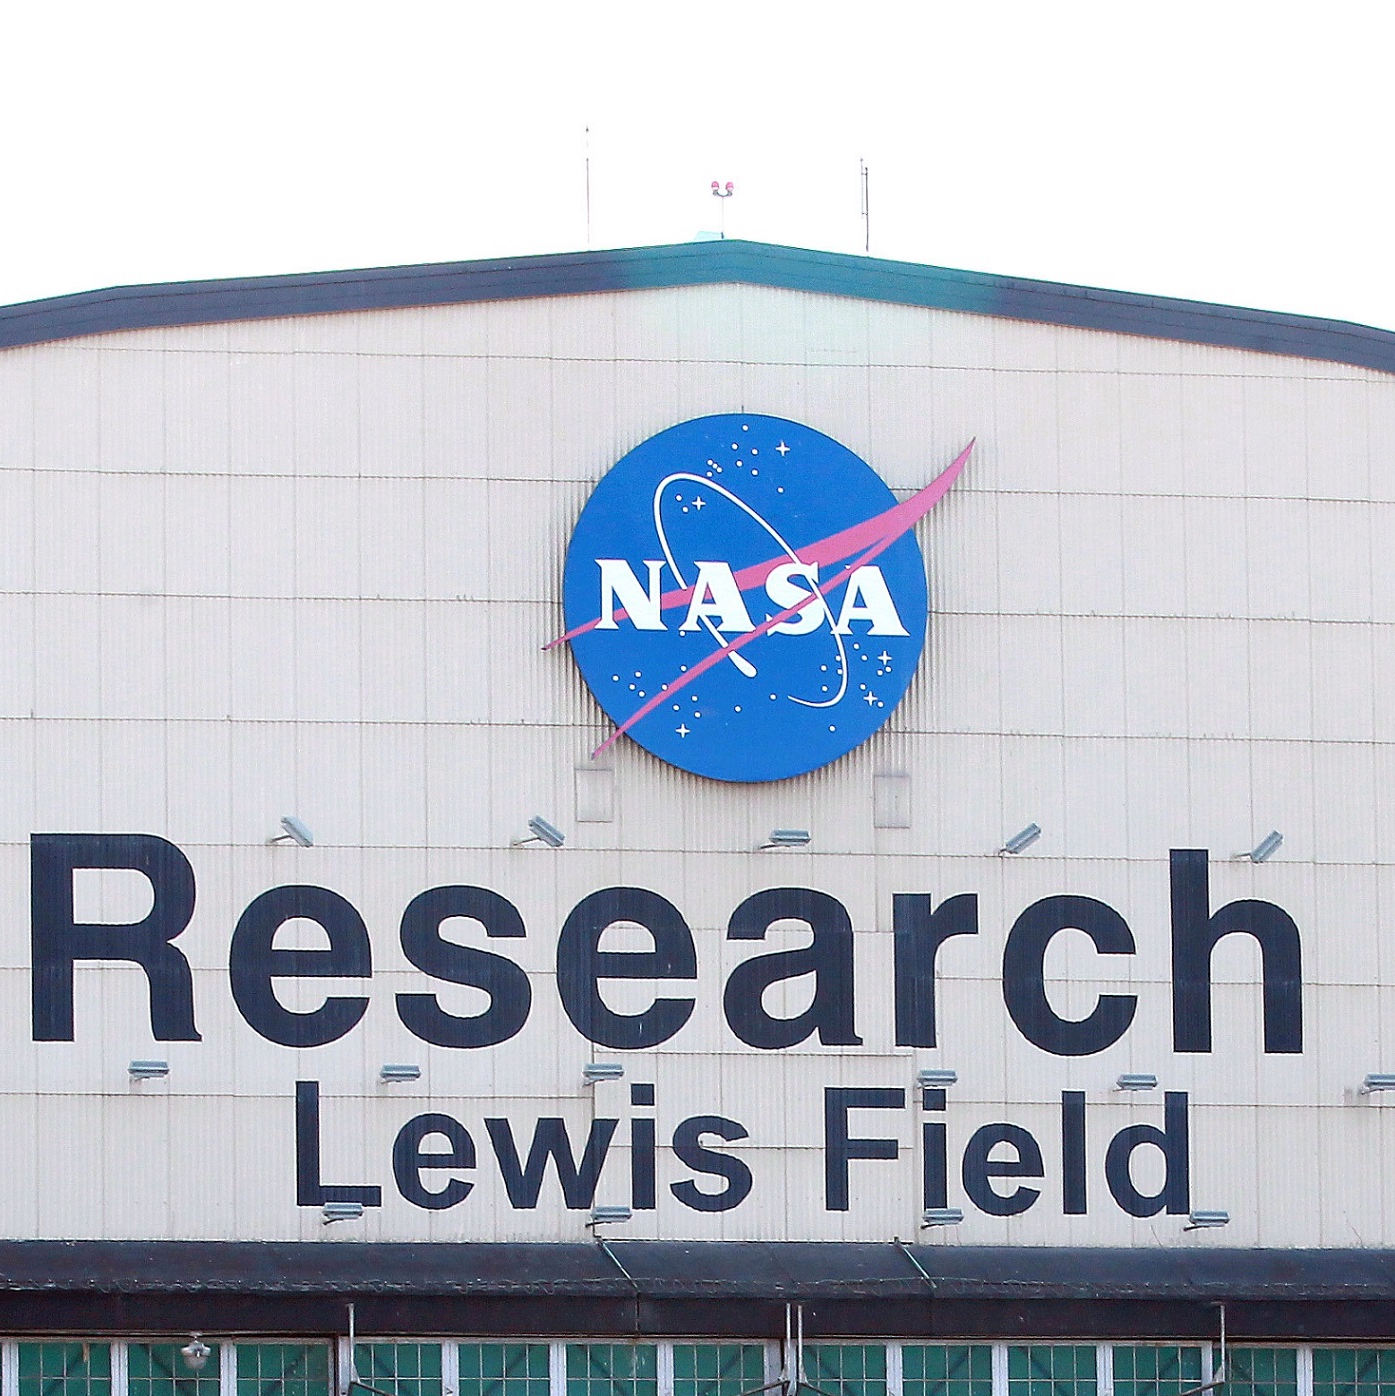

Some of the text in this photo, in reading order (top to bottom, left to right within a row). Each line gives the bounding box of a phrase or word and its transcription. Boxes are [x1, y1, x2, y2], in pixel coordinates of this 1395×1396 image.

[594, 558, 911, 638] NASA
[30, 833, 1304, 1057] Research
[296, 1080, 1192, 1219] Lewis Field
